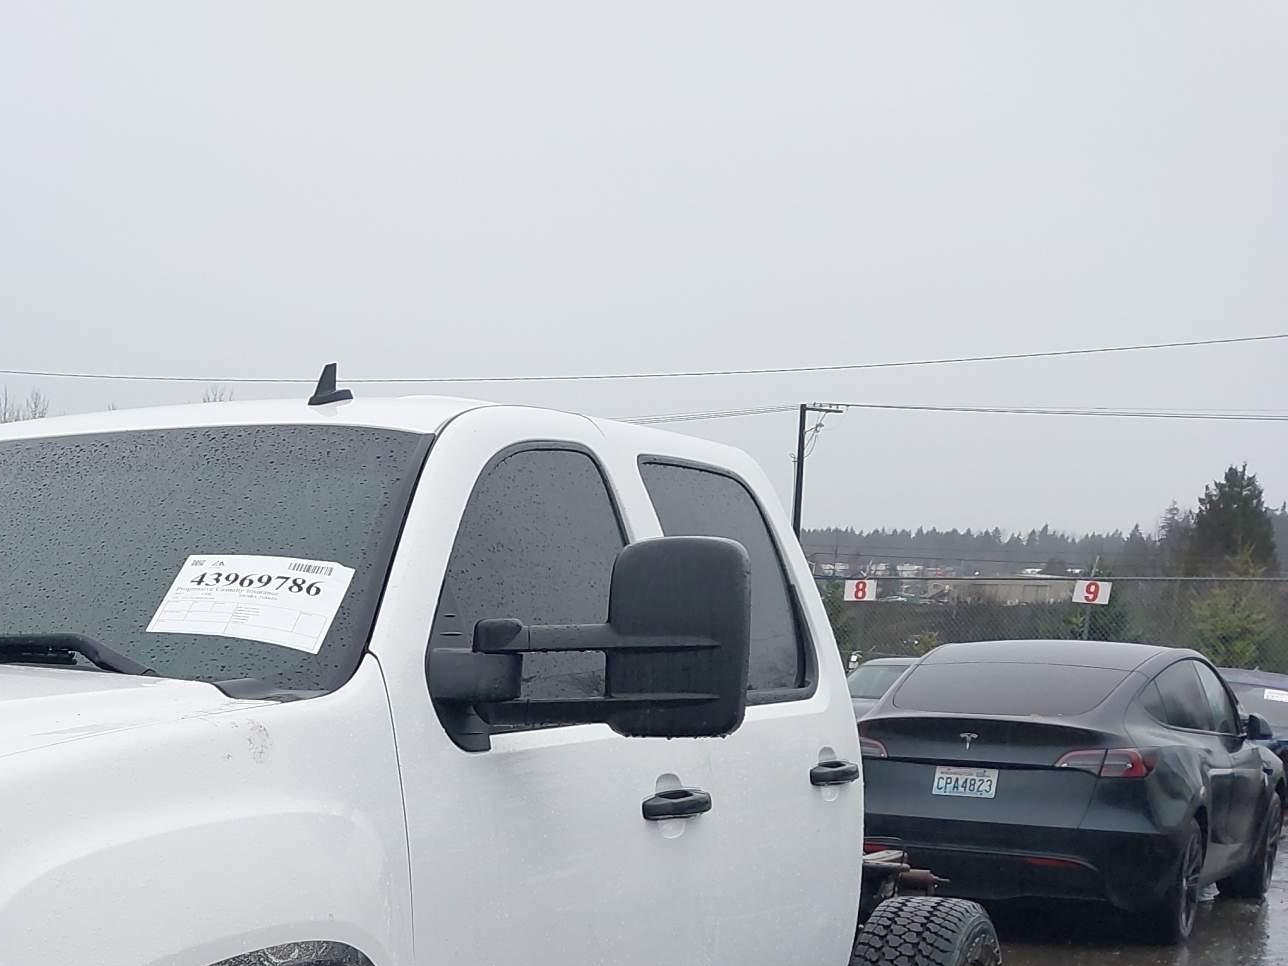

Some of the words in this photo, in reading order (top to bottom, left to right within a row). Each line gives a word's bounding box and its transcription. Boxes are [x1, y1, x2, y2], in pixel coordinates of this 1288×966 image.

[190, 571, 325, 597] 43969786
[853, 580, 867, 600] 8
[1084, 580, 1100, 602] 9
[936, 776, 993, 793] CPA4823
